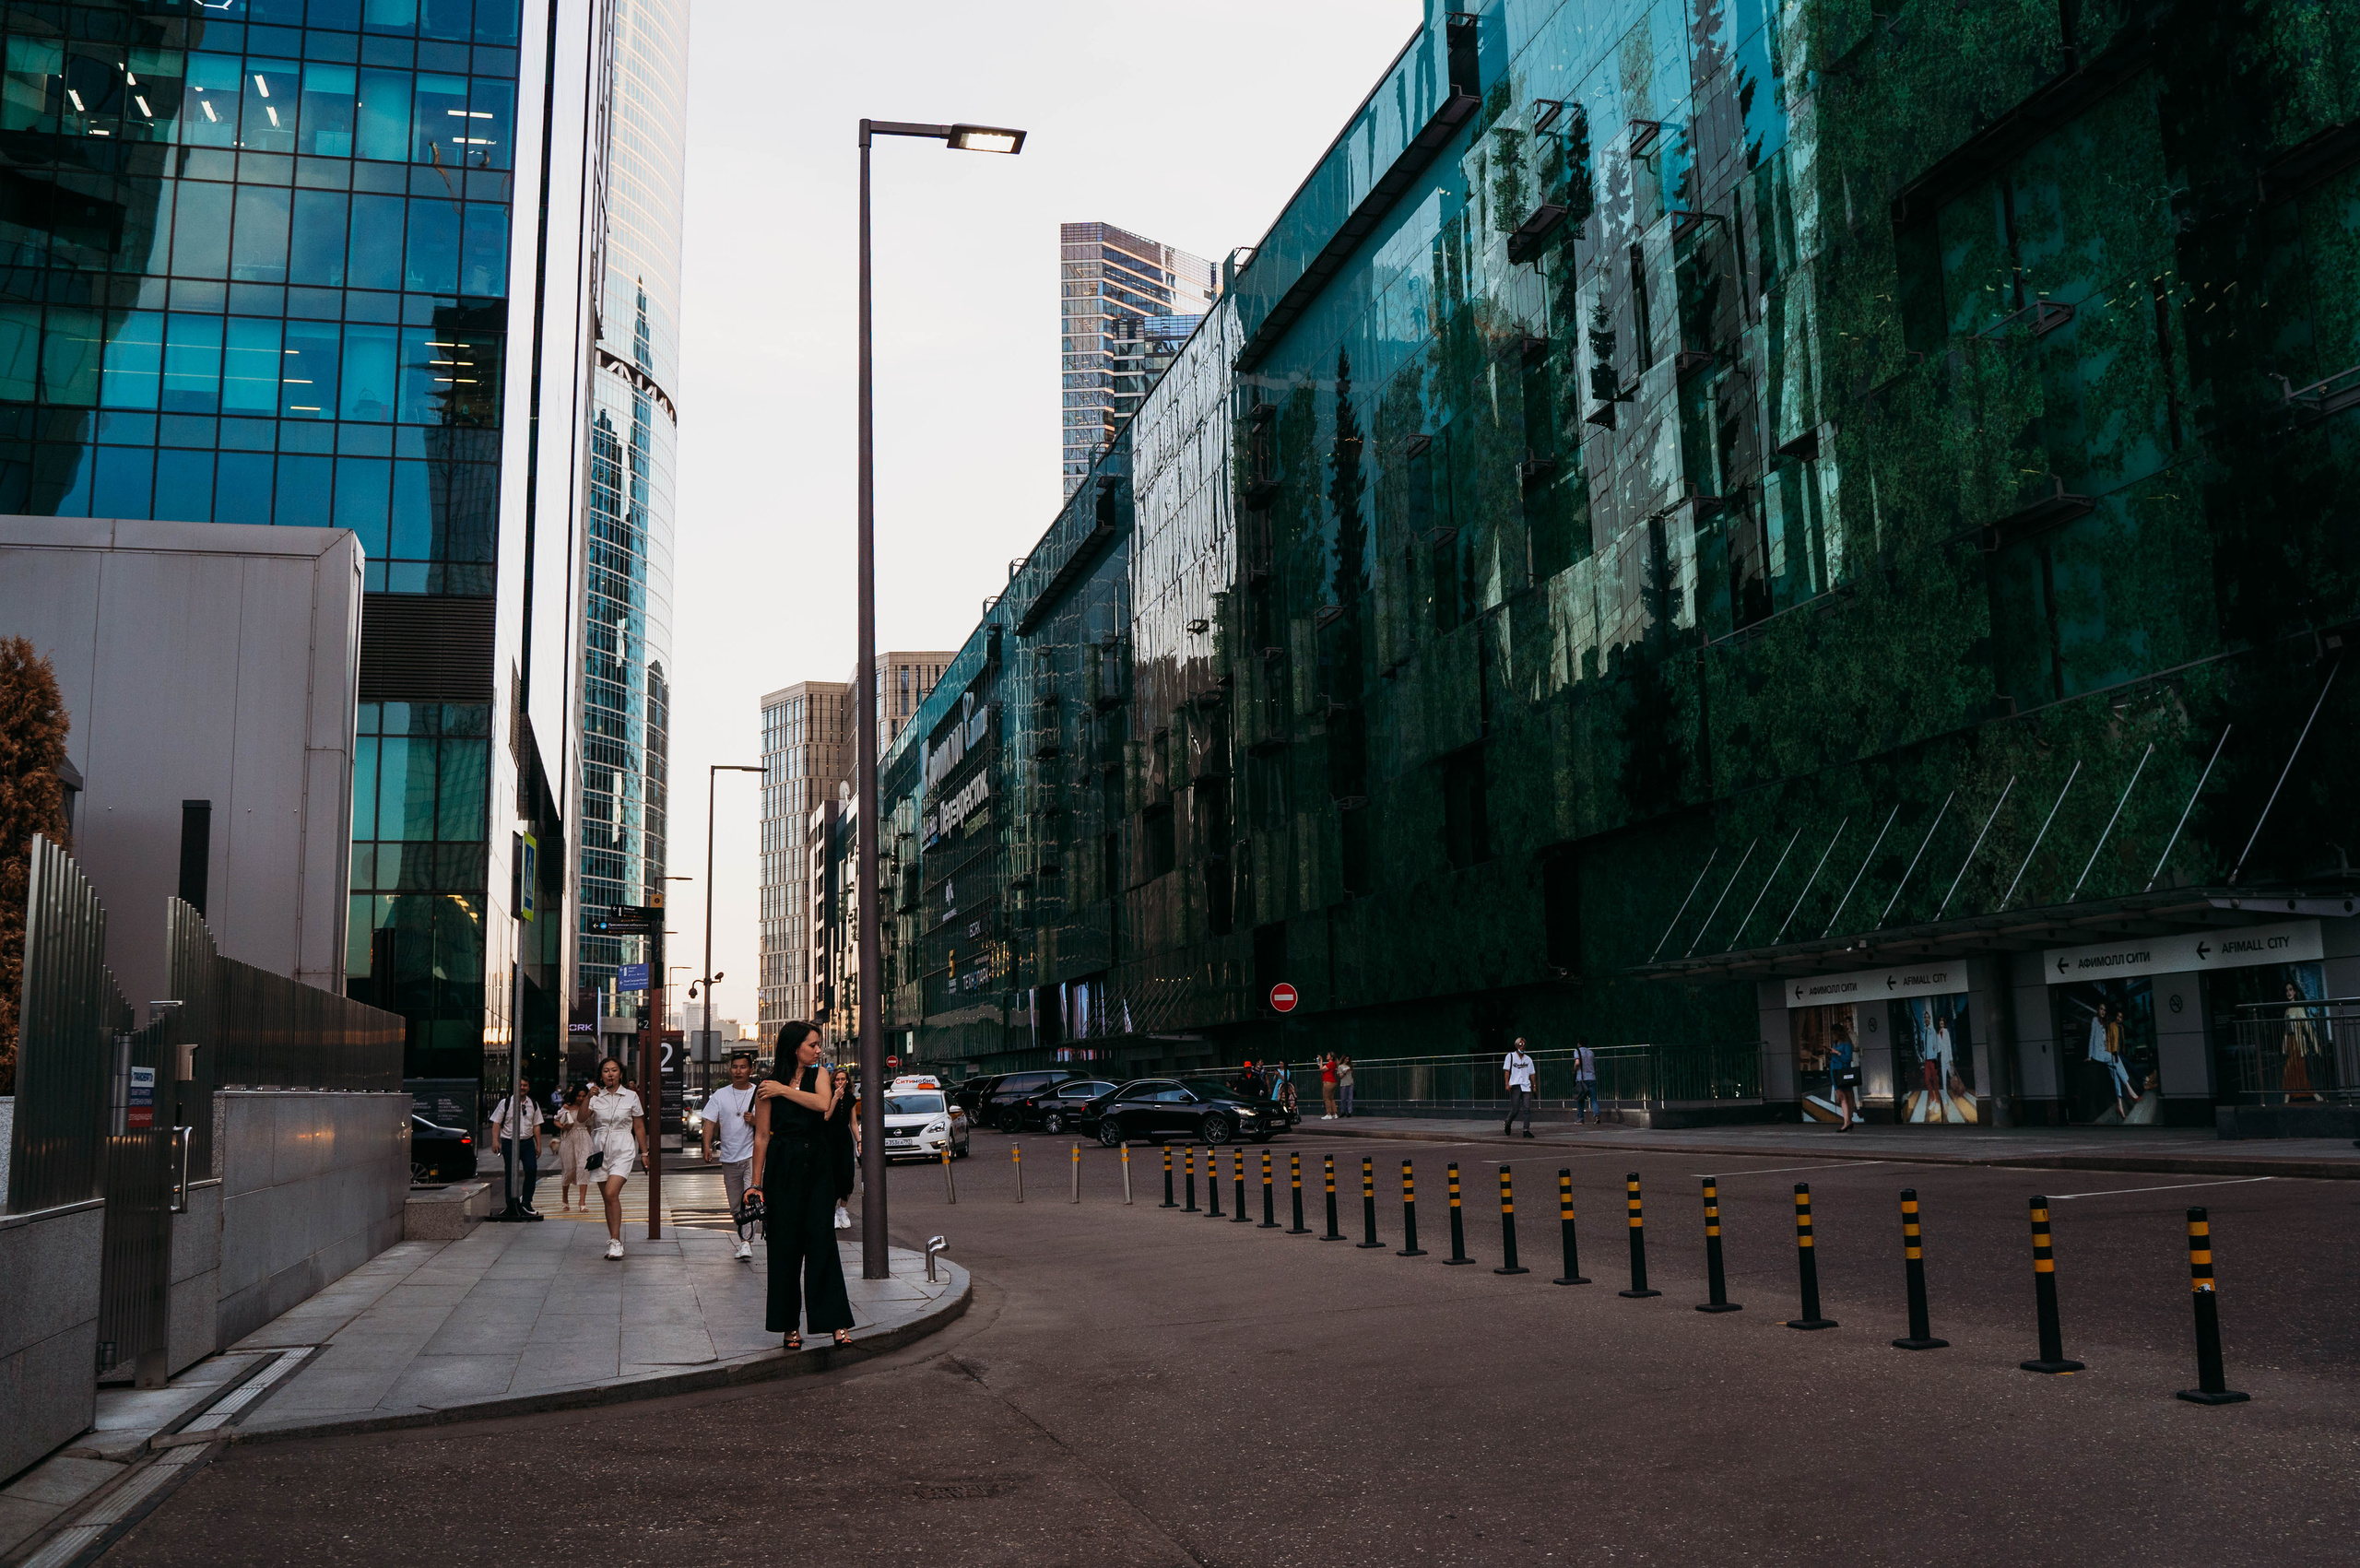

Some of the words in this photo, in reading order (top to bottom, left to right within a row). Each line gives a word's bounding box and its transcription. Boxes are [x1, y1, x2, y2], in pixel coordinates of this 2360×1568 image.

[2221, 939, 2264, 955] AFIMALL
[2267, 936, 2290, 949] CITY
[2078, 954, 2125, 969] АФИМОЛЛ
[2126, 951, 2151, 964] СИТИ
[1903, 974, 1930, 986] AFIMALL
[1932, 973, 1948, 984] CITY
[1809, 984, 1840, 996] АФИМОЛЛ
[1841, 982, 1858, 993] СИТИ
[661, 1043, 674, 1072] 2
